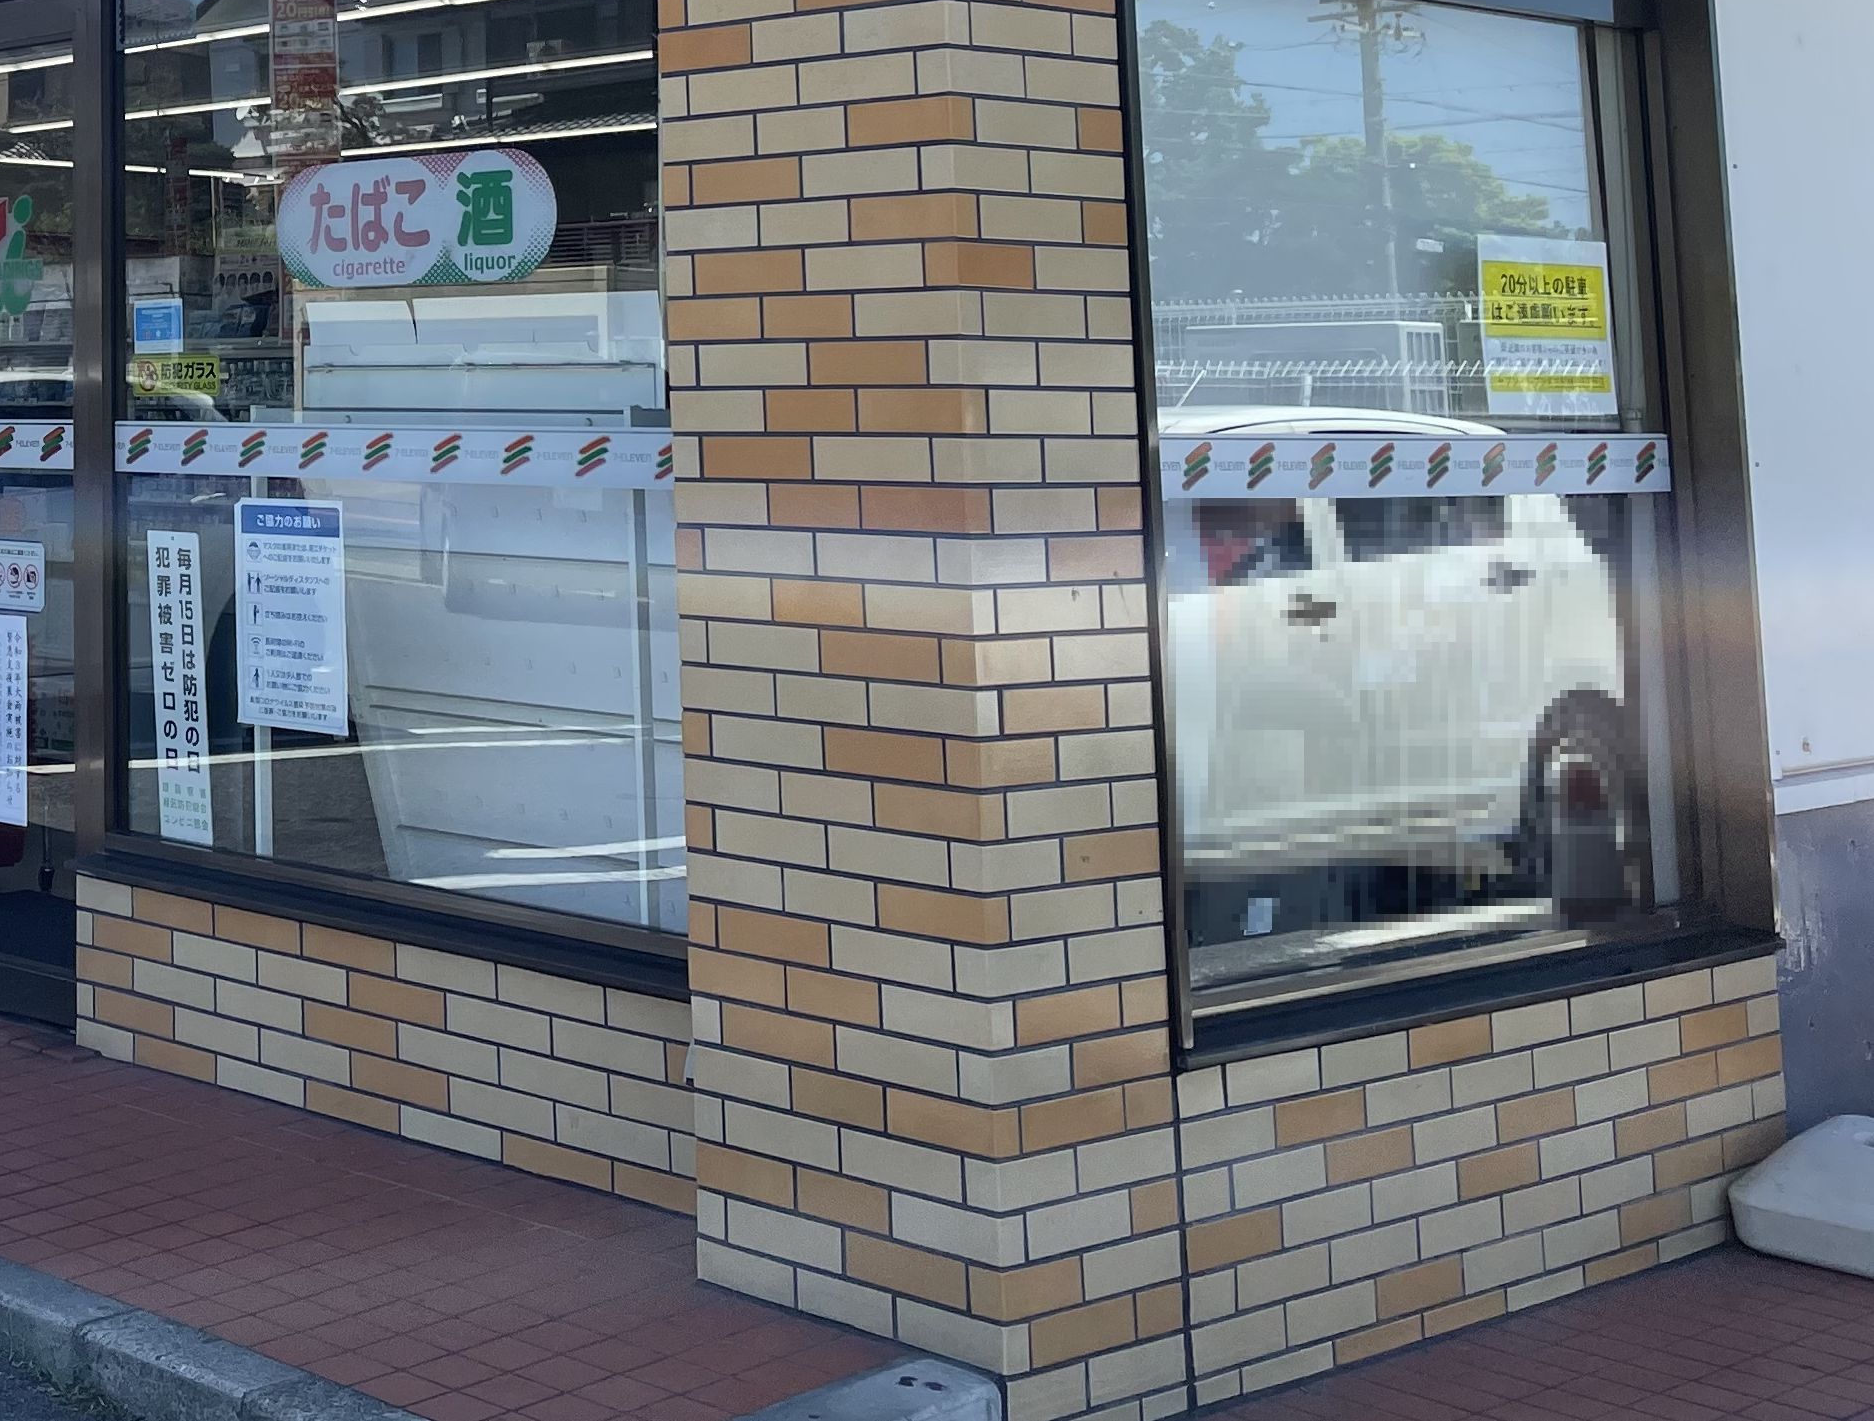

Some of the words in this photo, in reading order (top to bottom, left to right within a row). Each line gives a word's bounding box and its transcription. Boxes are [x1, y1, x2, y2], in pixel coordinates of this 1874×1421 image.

[309, 175, 431, 254] たばこ
[457, 169, 514, 247] 酒
[332, 257, 407, 278] cigarette
[464, 251, 517, 273] liquor
[1501, 273, 1588, 296] 20分以上の駐車
[161, 362, 217, 380] 防犯ガラス
[256, 514, 321, 529] ご協力のお願い
[155, 546, 179, 771] 犯罪被害ゼロの日
